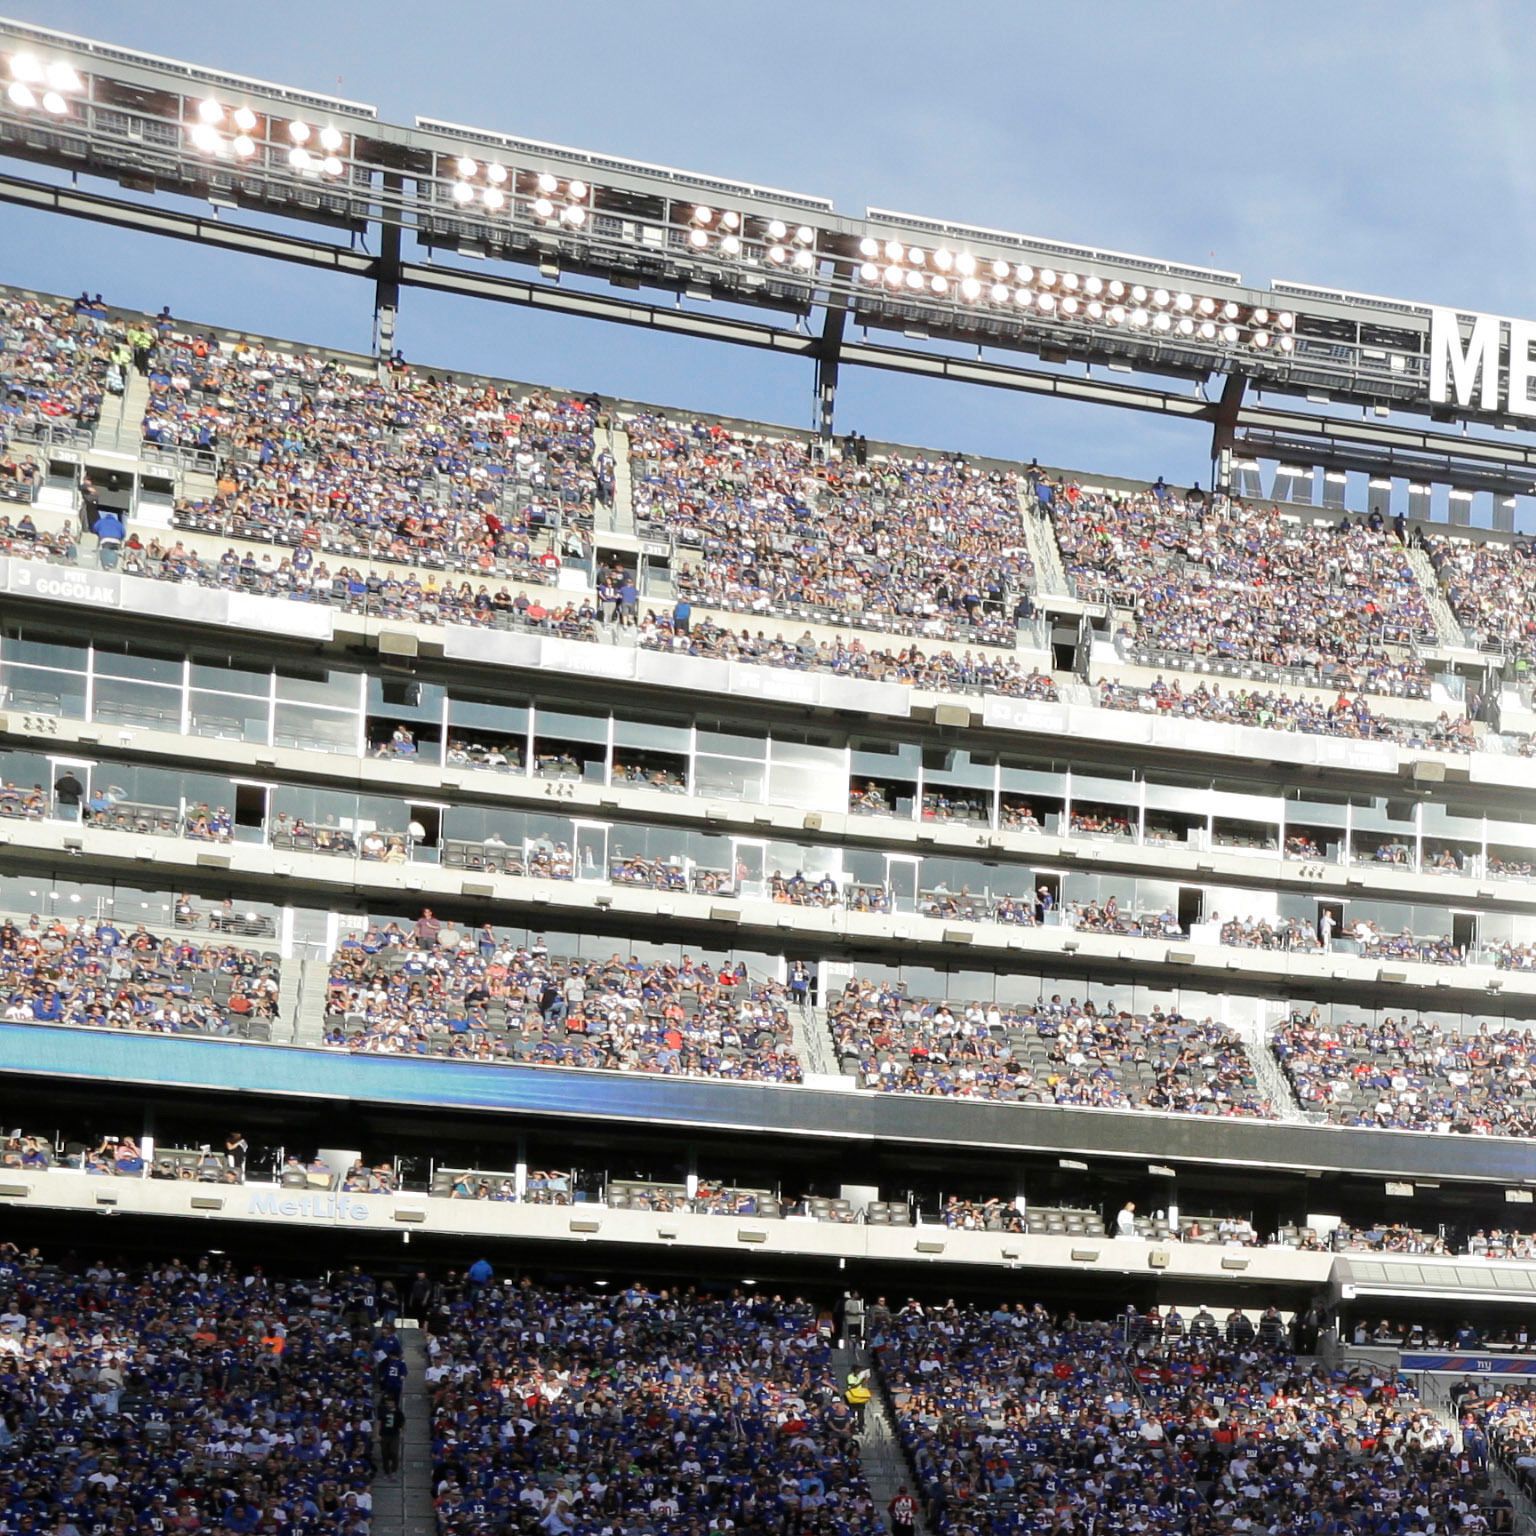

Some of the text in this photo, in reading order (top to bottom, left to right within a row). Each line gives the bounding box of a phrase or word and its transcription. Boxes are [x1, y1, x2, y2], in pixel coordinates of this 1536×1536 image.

[17, 568, 31, 586] 3
[36, 578, 114, 603] GOGOLAK
[248, 1193, 370, 1222] MetLife
